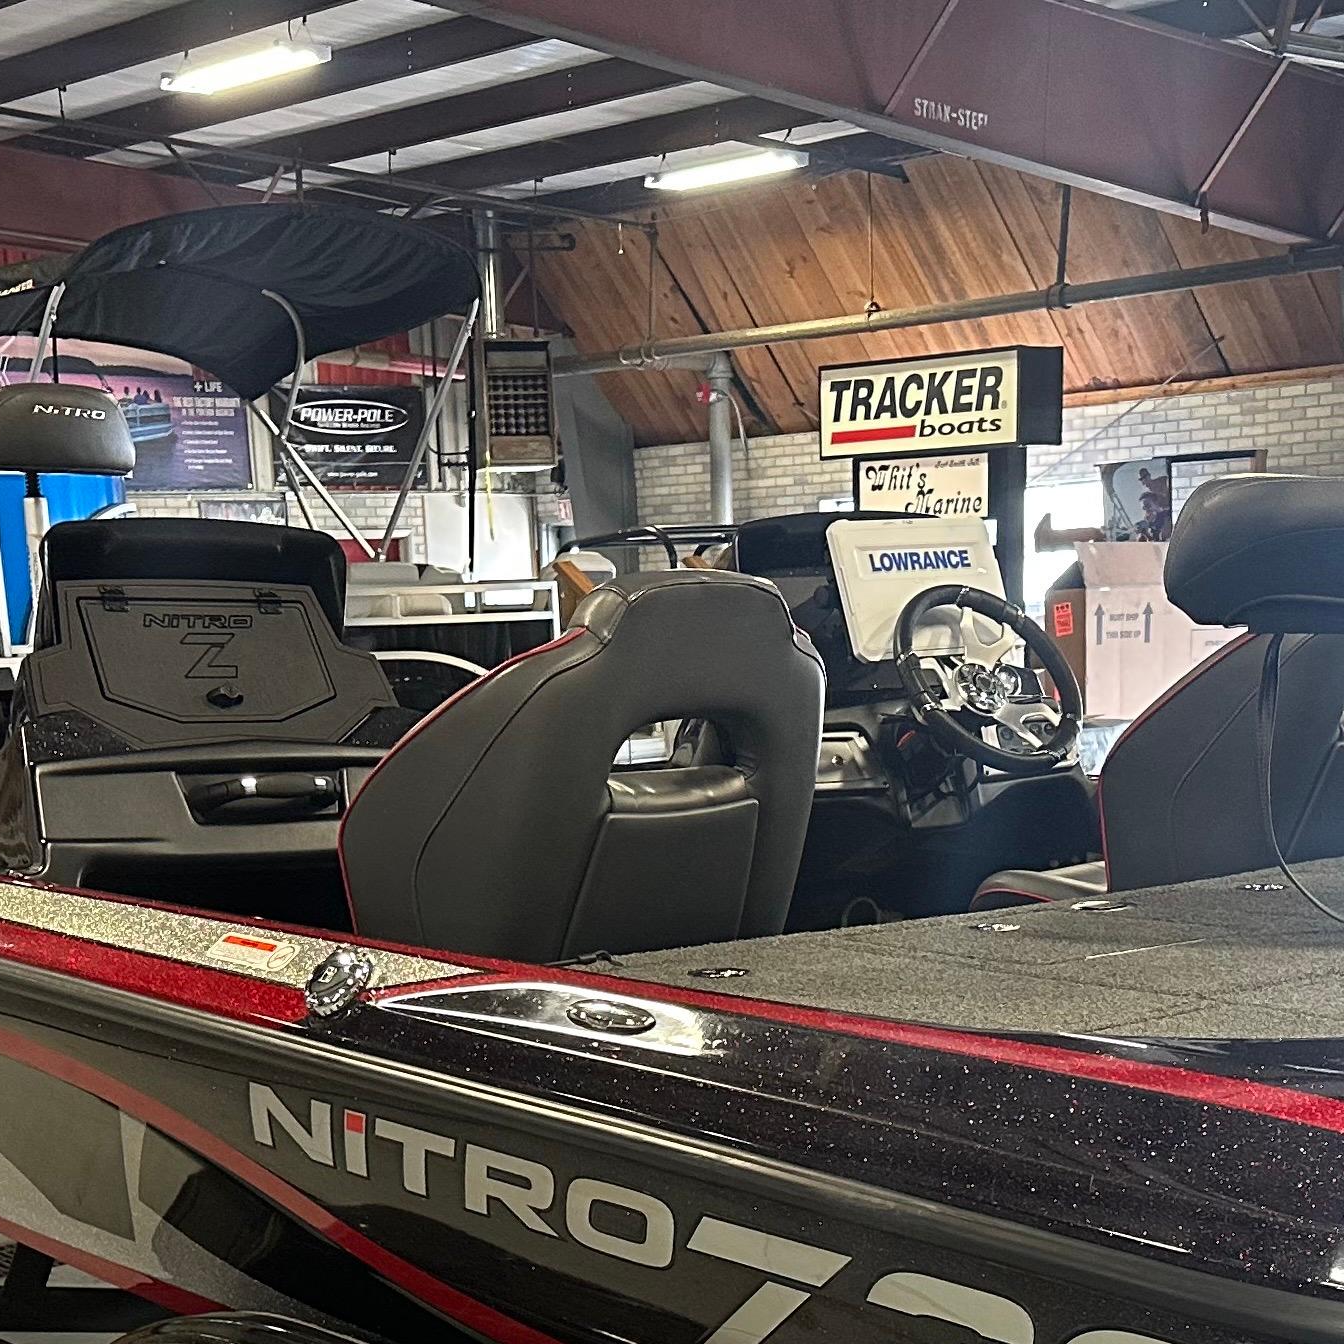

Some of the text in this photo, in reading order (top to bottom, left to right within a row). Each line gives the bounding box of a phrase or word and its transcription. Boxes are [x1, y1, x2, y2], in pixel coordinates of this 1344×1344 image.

[204, 381, 223, 392] LIFE
[830, 366, 1003, 422] TRACKER
[300, 408, 394, 422] POWER-POLE
[919, 417, 1002, 438] boats
[865, 462, 927, 492] Whit's
[905, 488, 983, 515] Marine
[868, 549, 972, 572] LOWRANCE
[143, 613, 253, 628] NITRO
[180, 633, 238, 678] Z
[247, 1081, 675, 1270] NITRO
